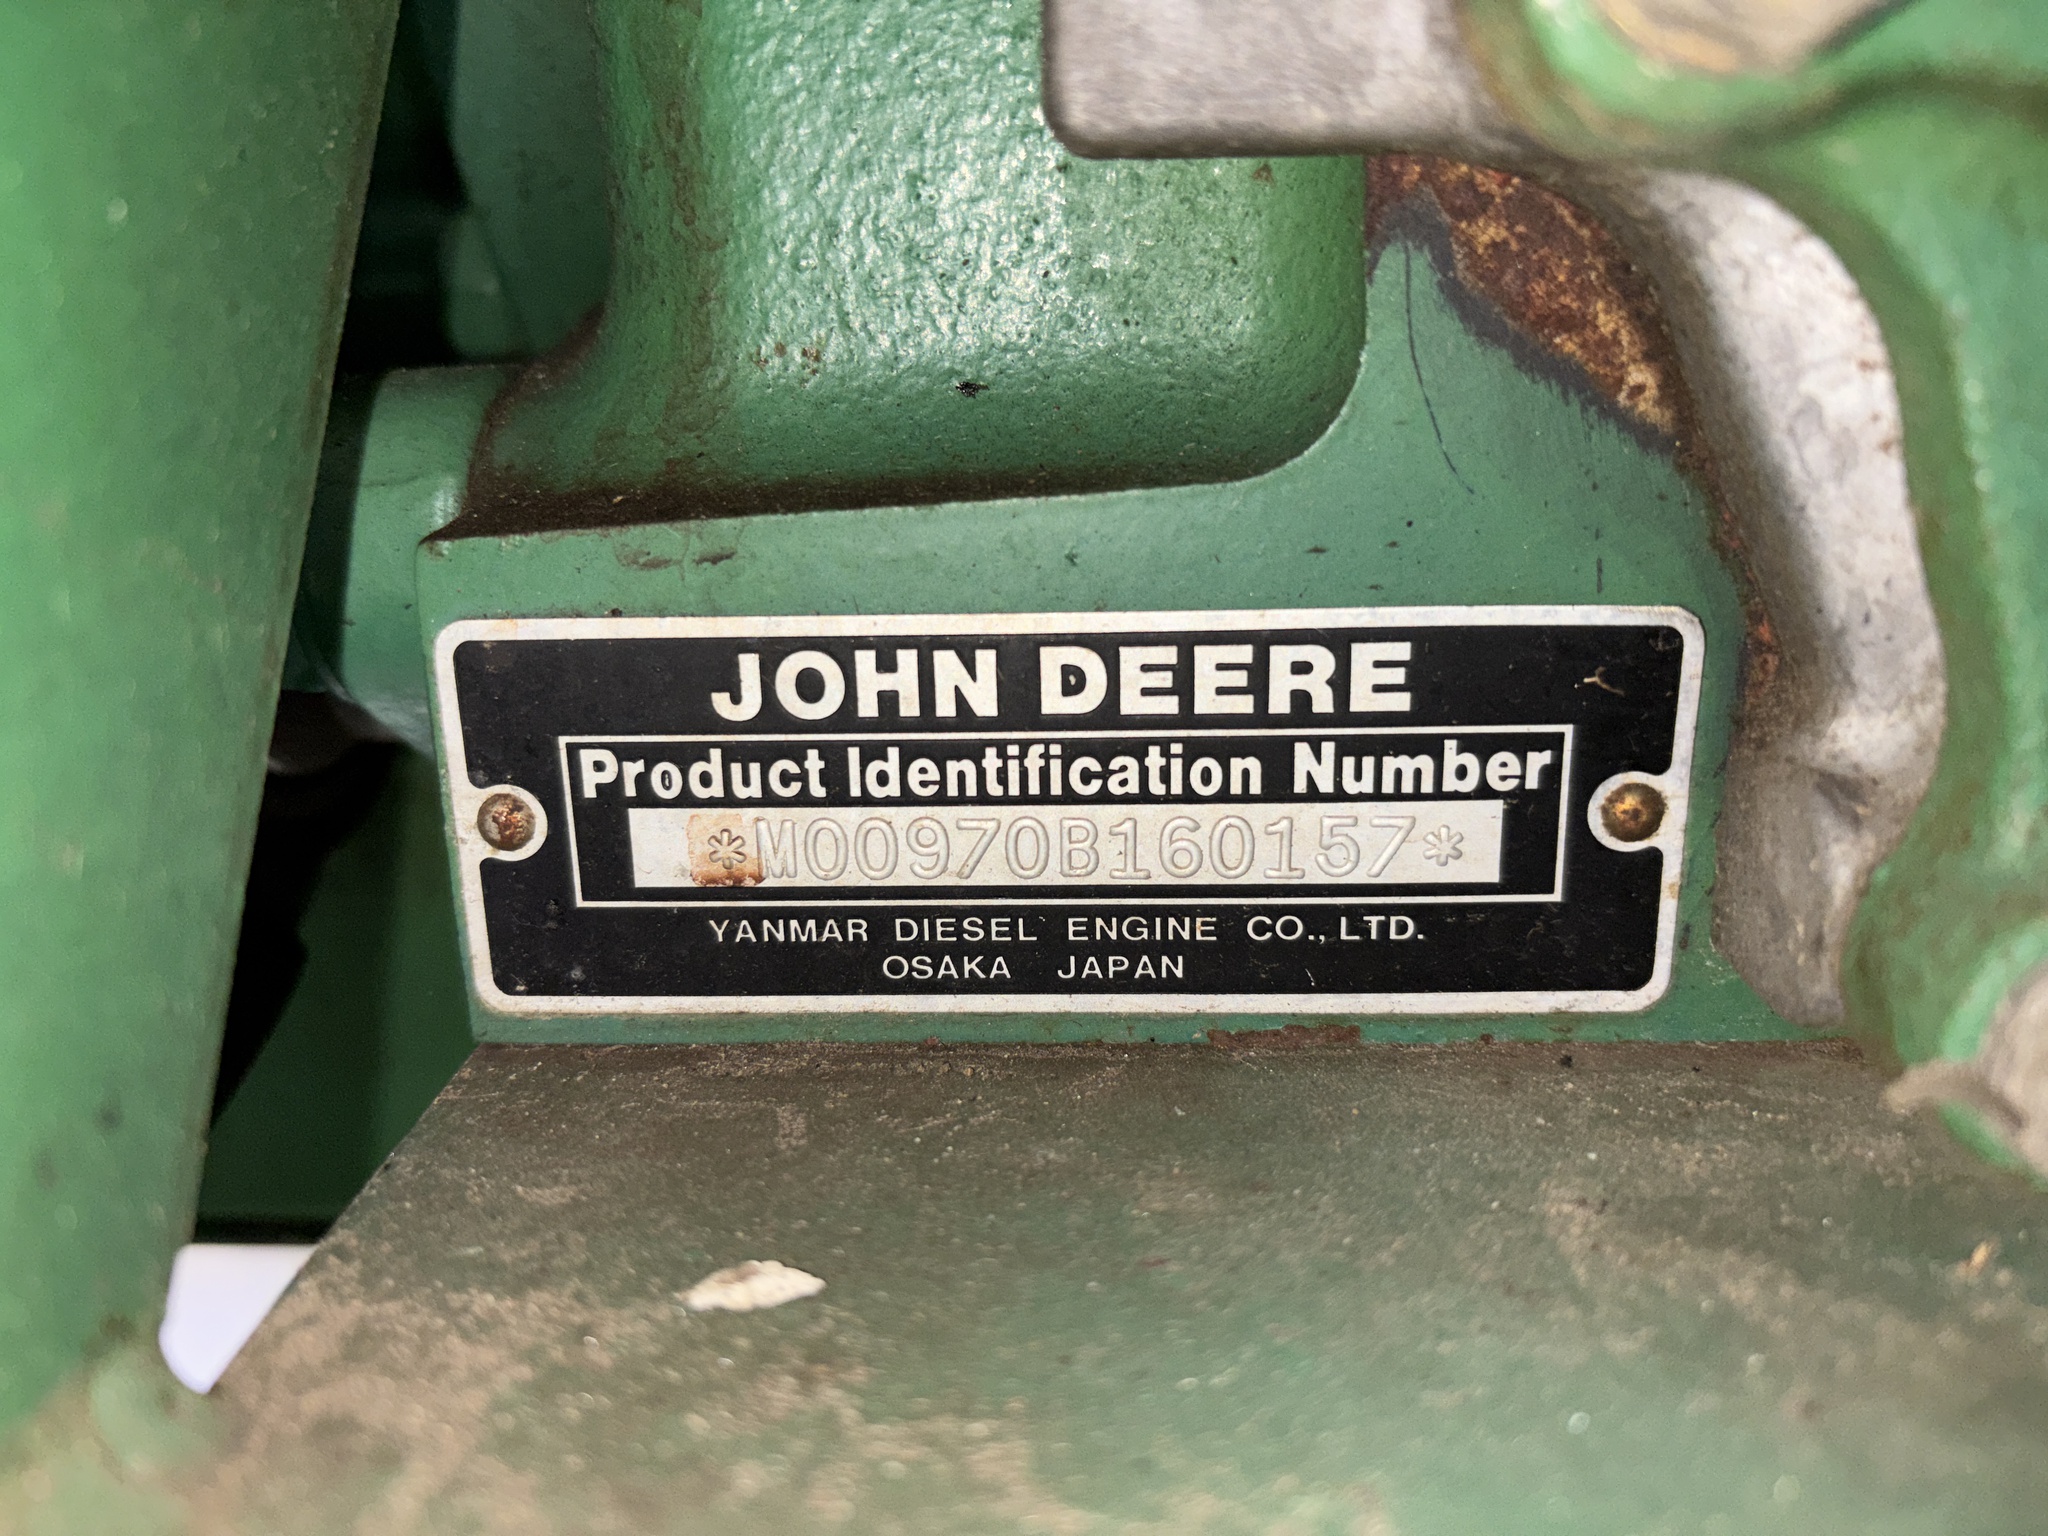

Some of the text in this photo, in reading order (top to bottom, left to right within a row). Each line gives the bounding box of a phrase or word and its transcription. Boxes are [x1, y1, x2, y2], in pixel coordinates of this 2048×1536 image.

[710, 641, 1413, 722] JOHN DEERE
[578, 738, 1553, 800] Product Identification Number
[707, 918, 869, 943] YANMAR
[894, 916, 1038, 942] DIESEL
[1067, 916, 1218, 942] ENGINE
[882, 954, 1184, 980] OSAKA JAPAN
